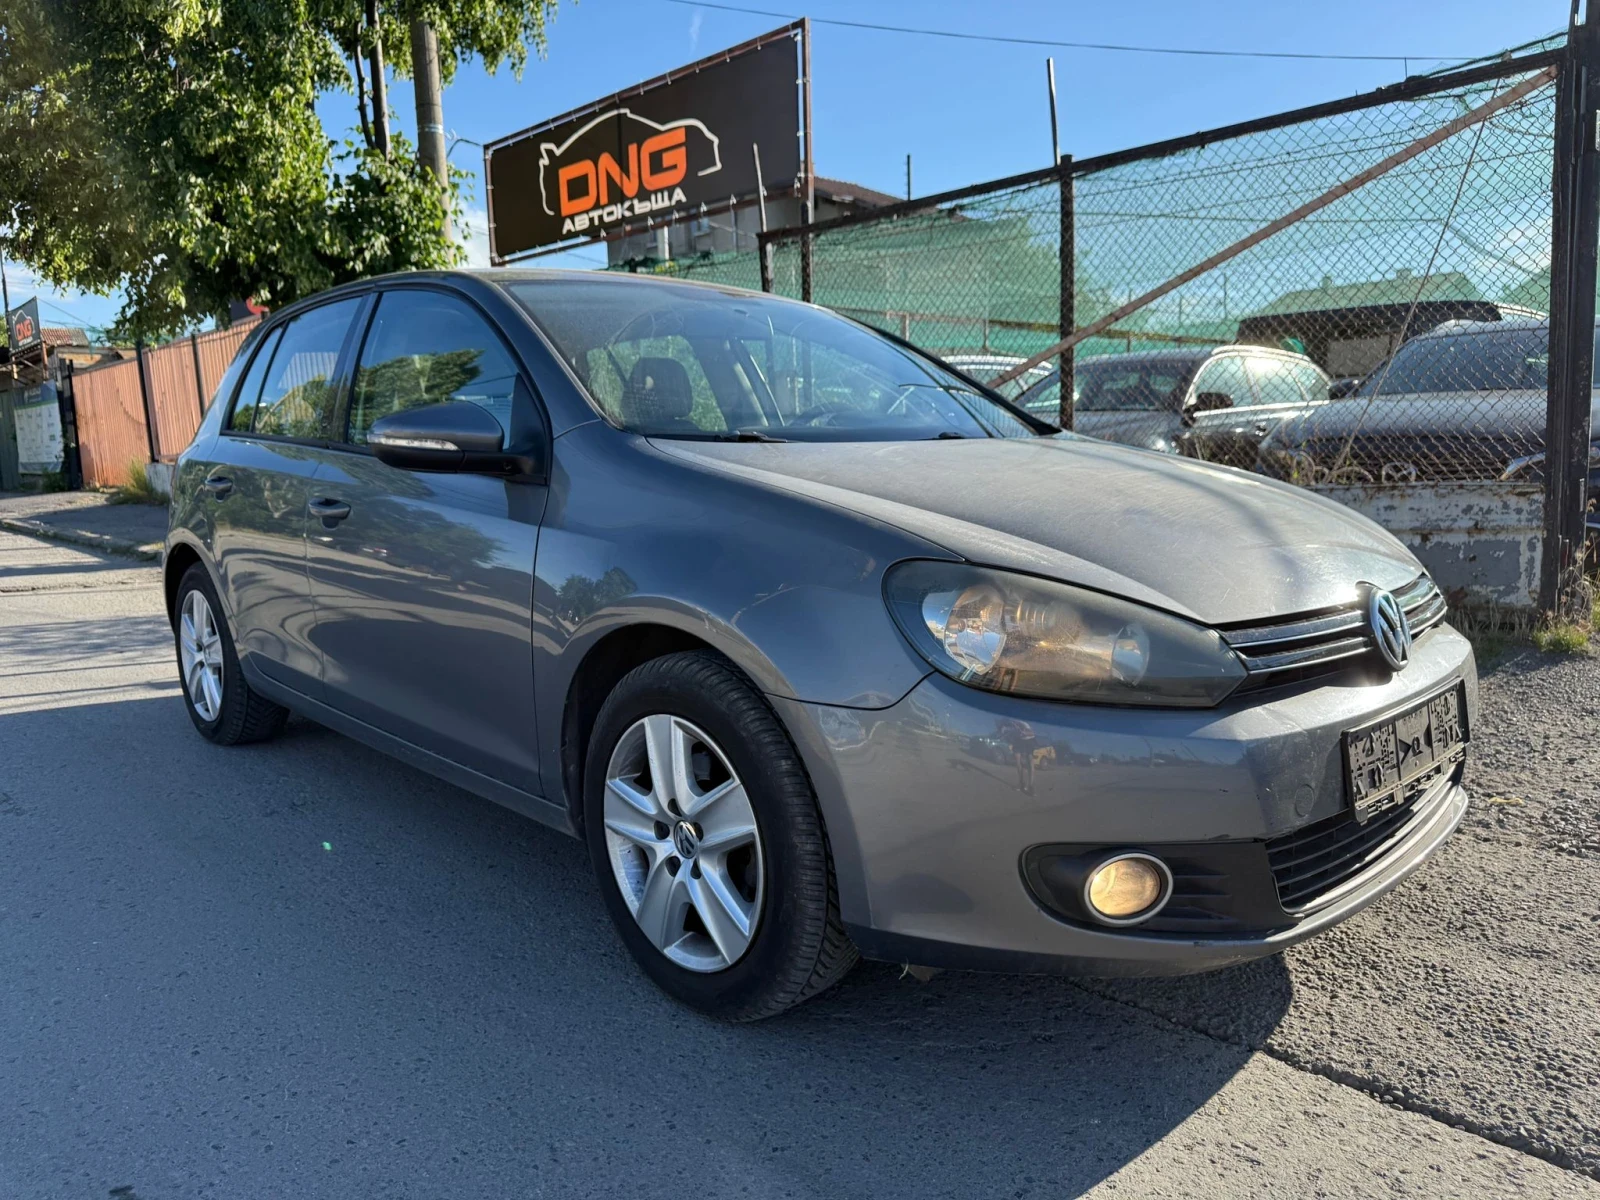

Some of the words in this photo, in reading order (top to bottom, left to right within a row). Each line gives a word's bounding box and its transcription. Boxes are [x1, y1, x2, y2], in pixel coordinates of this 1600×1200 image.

[558, 126, 687, 217] DNG
[562, 187, 687, 235] АВТОКЪЩА
[16, 319, 33, 341] DNG
